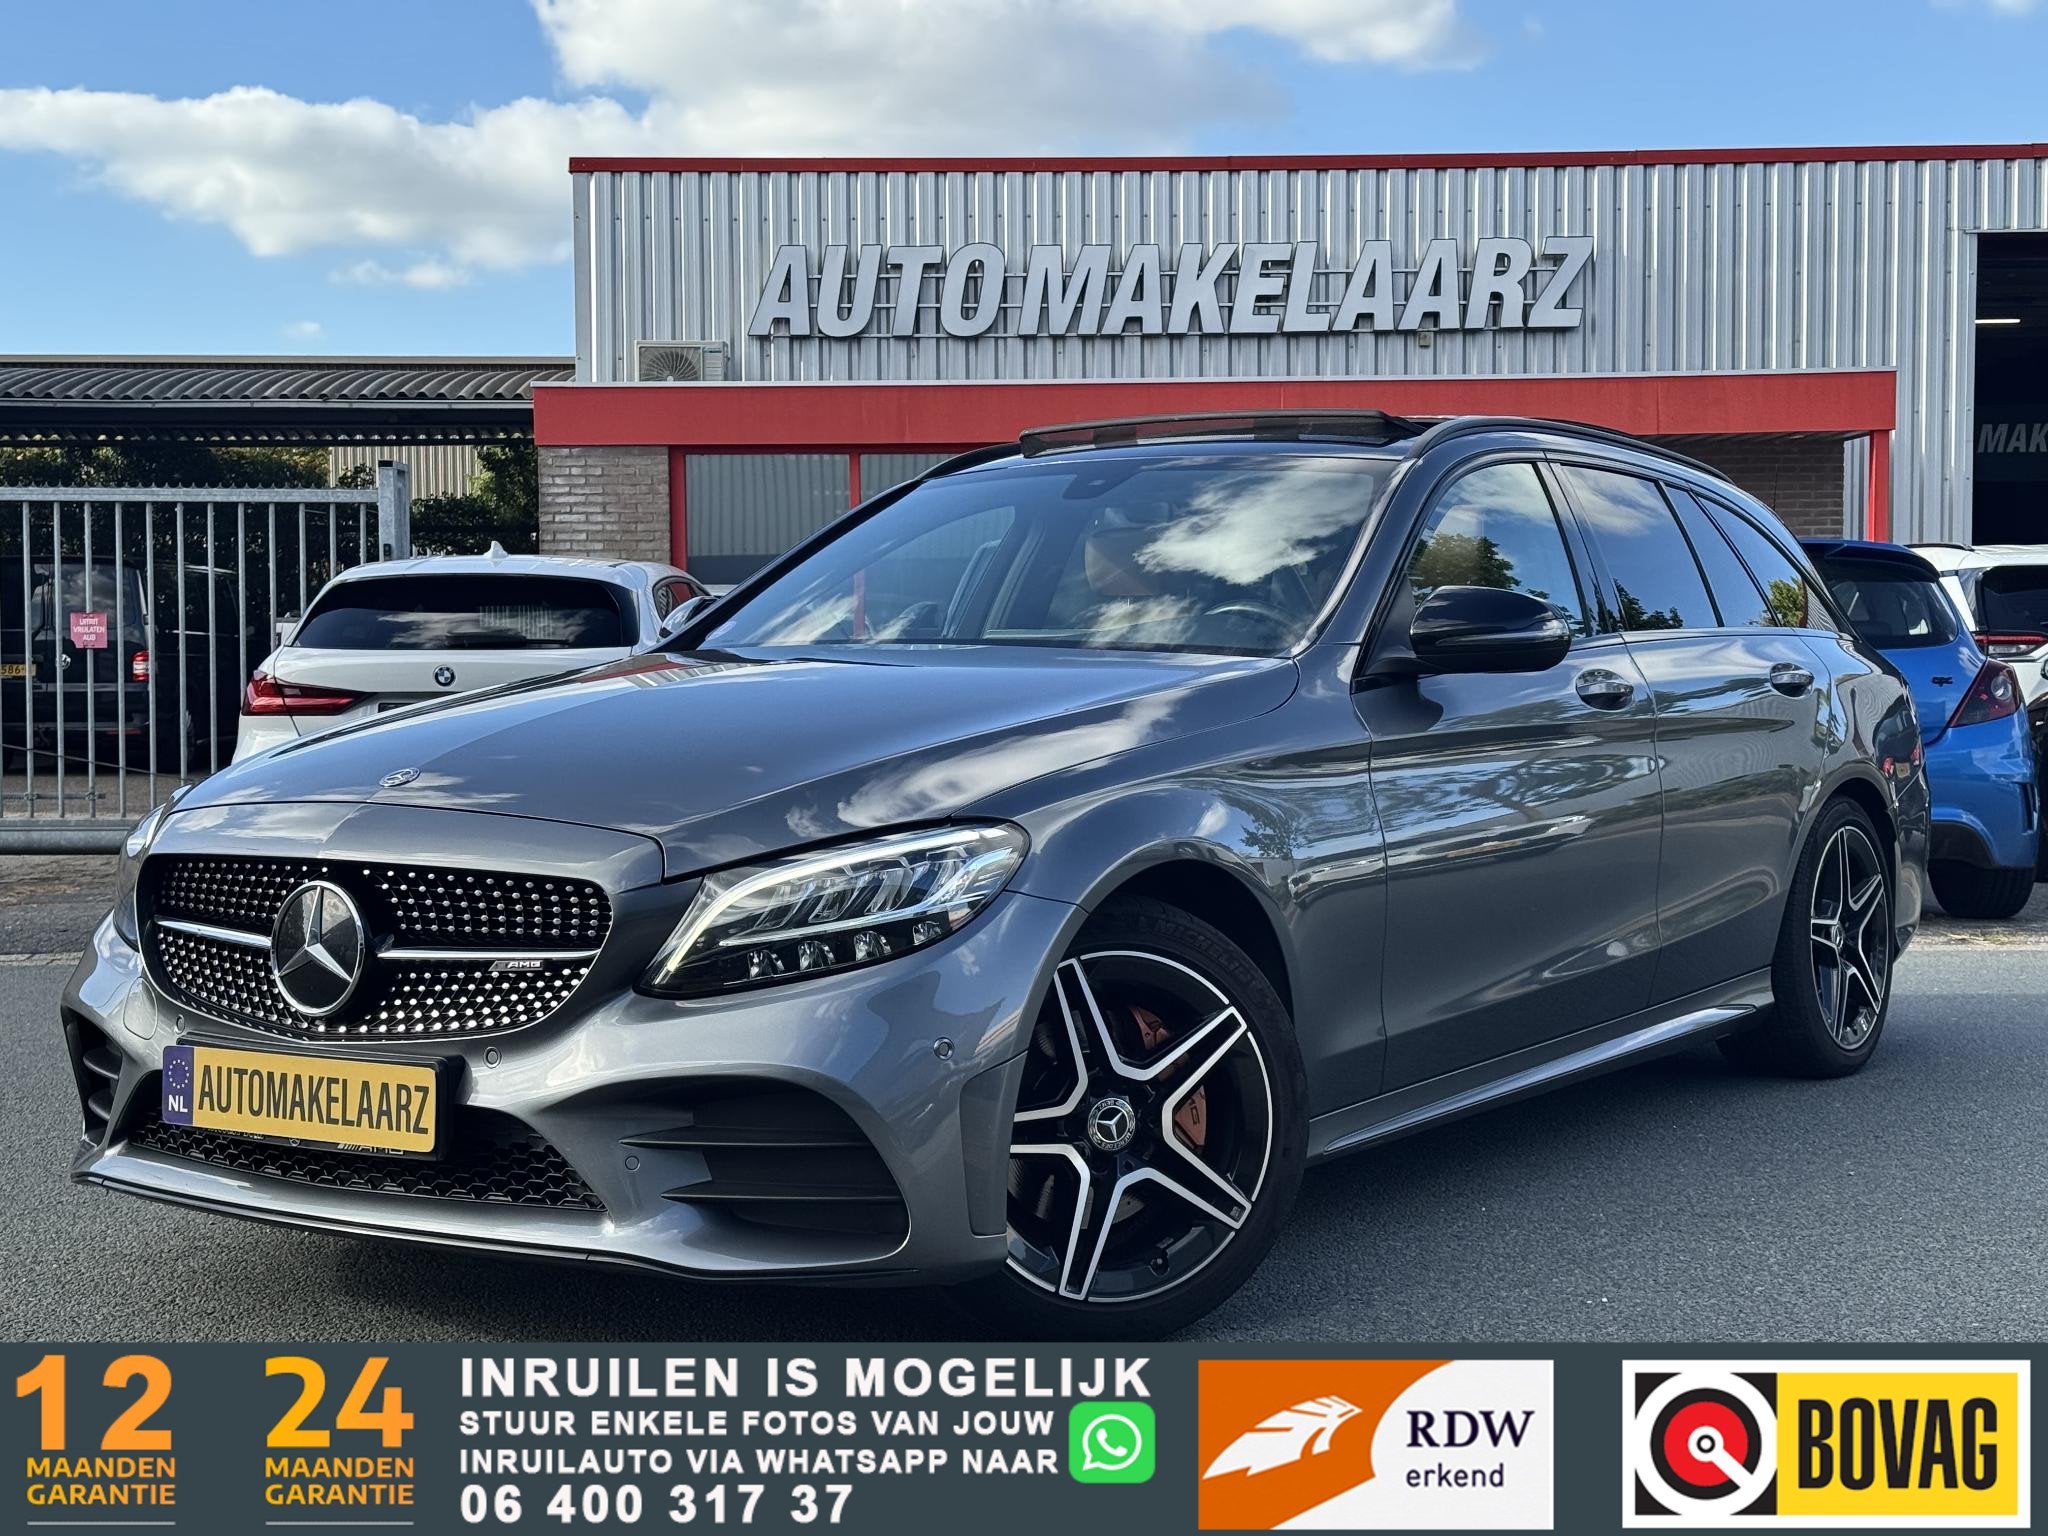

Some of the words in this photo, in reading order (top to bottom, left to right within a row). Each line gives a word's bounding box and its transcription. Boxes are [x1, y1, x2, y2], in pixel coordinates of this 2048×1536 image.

[507, 961, 542, 969] AMG
[168, 1094, 188, 1113] NL
[198, 1064, 430, 1135] AUTOMAKELAARZ
